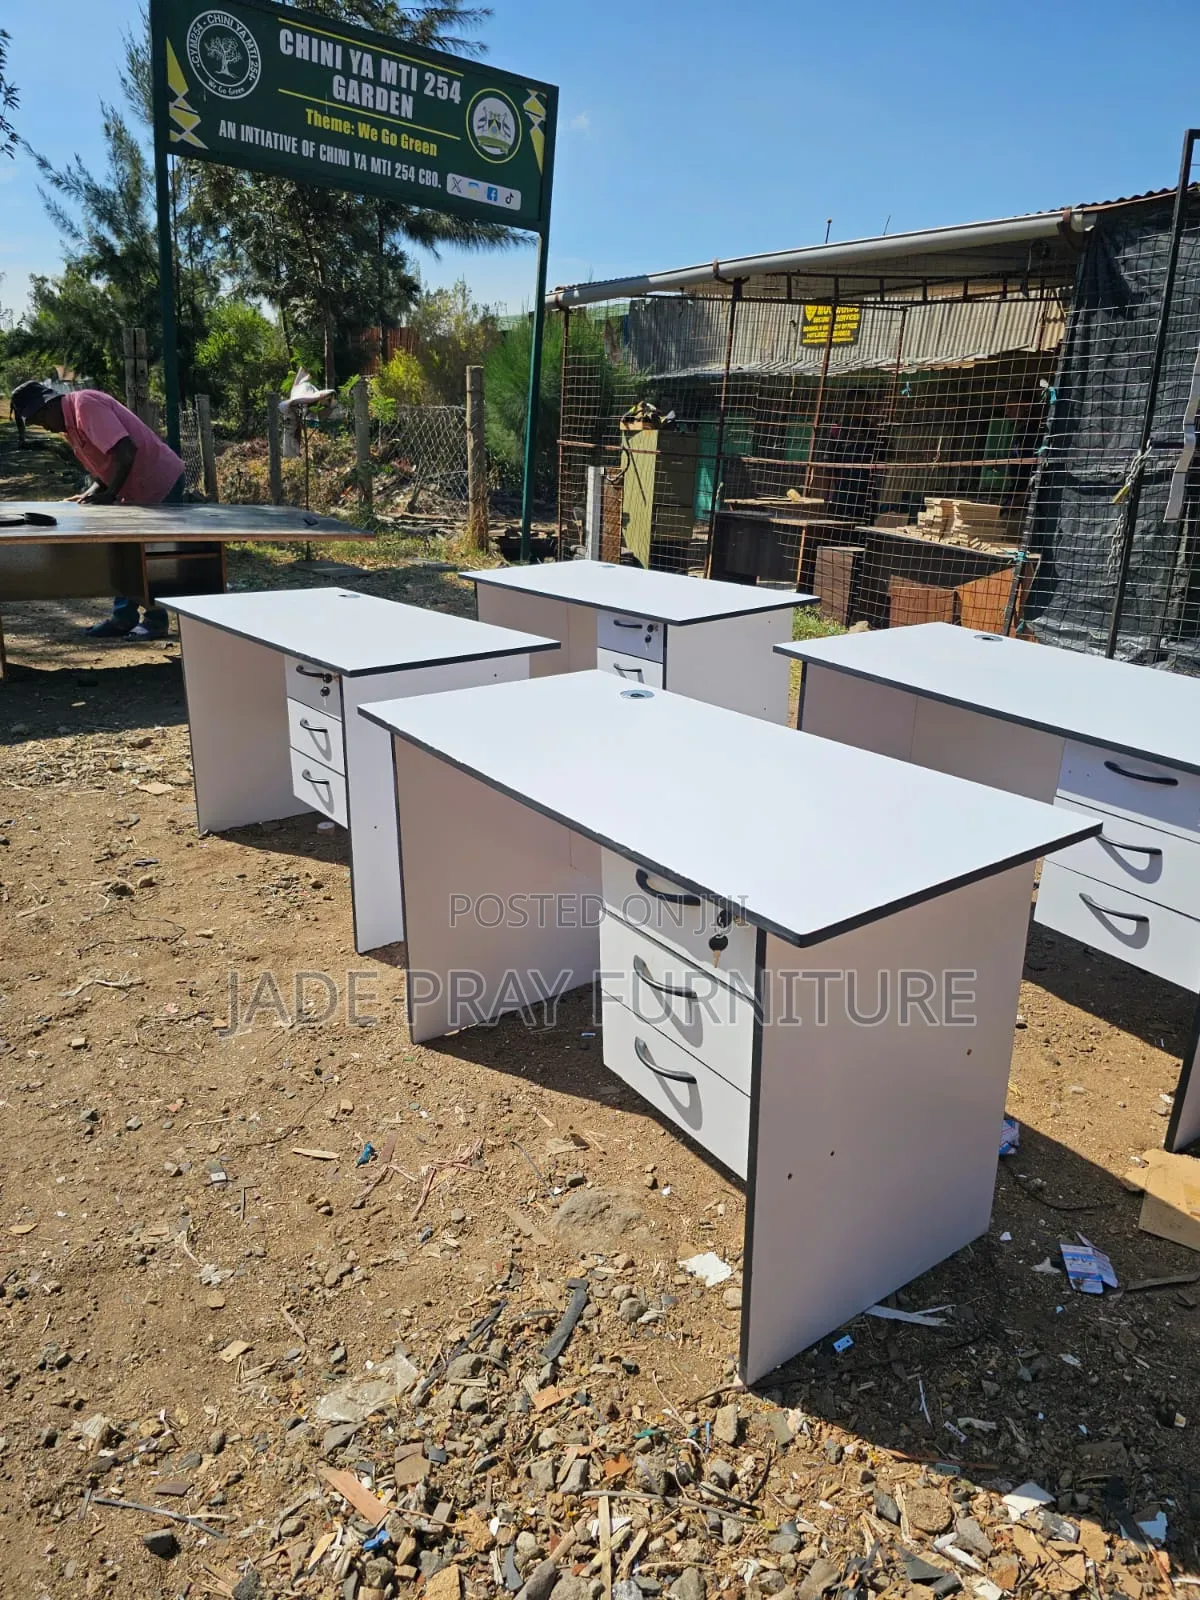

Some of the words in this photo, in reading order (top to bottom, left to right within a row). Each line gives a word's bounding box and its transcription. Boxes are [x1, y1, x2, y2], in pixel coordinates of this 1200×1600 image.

[207, 14, 234, 27] CHINI
[236, 24, 246, 39] YA
[246, 39, 258, 58] MTI
[249, 61, 258, 79] 254
[279, 28, 342, 70] CHINI
[350, 50, 374, 78] YA
[381, 58, 418, 90] MTI
[424, 74, 462, 104] 254
[333, 76, 413, 119] GARDEN
[306, 108, 355, 136] Theme:
[358, 122, 379, 142] We
[381, 128, 398, 147] Go
[400, 133, 437, 156] Green
[219, 119, 236, 139] AN
[240, 124, 298, 154] INTIATIVE
[301, 136, 316, 156] OF
[319, 139, 350, 167] CHINI
[354, 151, 368, 171] YA
[370, 155, 391, 176] MTI
[394, 163, 416, 182] 254
